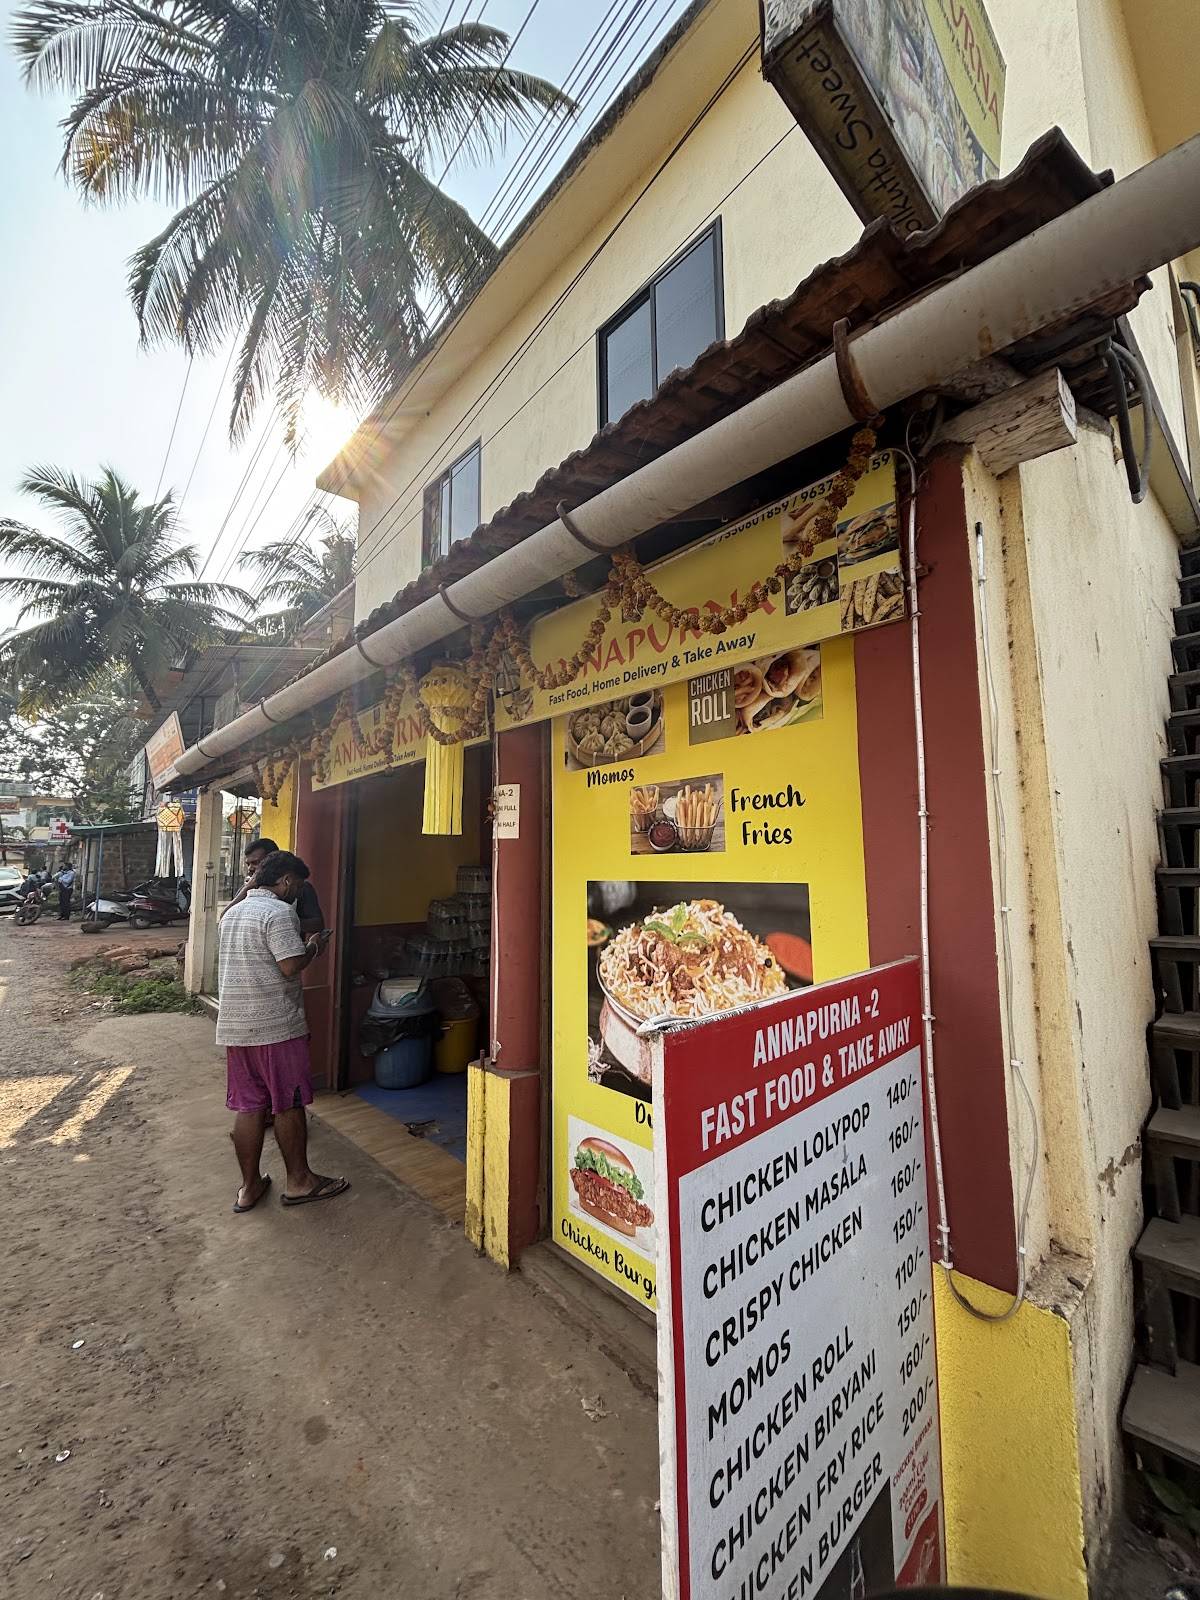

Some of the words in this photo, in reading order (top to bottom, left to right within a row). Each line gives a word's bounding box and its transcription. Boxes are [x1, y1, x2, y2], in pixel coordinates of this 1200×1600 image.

[796, 40, 873, 150] Sweet
[868, 147, 922, 232] olkutta
[800, 451, 890, 503] 963759
[549, 694, 566, 706] Fast
[566, 683, 590, 701] Food,
[592, 676, 620, 696] Home
[623, 659, 668, 683] Delivery
[671, 655, 681, 669] &
[683, 646, 713, 667] Take
[716, 633, 756, 655] Away
[690, 669, 731, 696] CHICKEN
[691, 692, 731, 727] ROLL
[587, 768, 635, 788] Momos
[730, 784, 805, 813] French
[742, 821, 793, 846] Fries
[753, 995, 861, 1068] ANNAPURNA
[701, 1088, 757, 1151] FAST
[765, 1062, 816, 1118] FOOD
[822, 1054, 834, 1088] &
[839, 1034, 874, 1078] TAKE
[878, 1016, 911, 1058] AWAY
[886, 1073, 917, 1109] 140/-
[888, 1115, 919, 1153] 160/-
[701, 1147, 798, 1232] CHICKEN
[803, 1101, 870, 1167] LOLYPOP
[891, 1158, 921, 1198] 160/-
[561, 1218, 610, 1265] Chicken
[703, 1202, 800, 1299] CHICKEN
[805, 1153, 867, 1222] MASALA
[893, 1201, 923, 1244] 150/-
[705, 1272, 784, 1367] CRISPY
[789, 1206, 862, 1291] CHICKEN
[895, 1245, 924, 1290] 110/-
[897, 1288, 927, 1339] 150/-
[708, 1329, 791, 1442] MOMOS
[900, 1332, 930, 1386] 160/-
[709, 1374, 807, 1509] CHICKEN
[812, 1325, 854, 1391] ROLL
[903, 1376, 934, 1437] 200/-
[711, 1432, 809, 1580] CHICKEN
[815, 1348, 876, 1451] BIRYANI
[731, 1493, 811, 1600] ICKEN
[817, 1441, 848, 1510] FRY
[852, 1391, 884, 1459] RICE
[819, 1451, 883, 1569] BURGER
